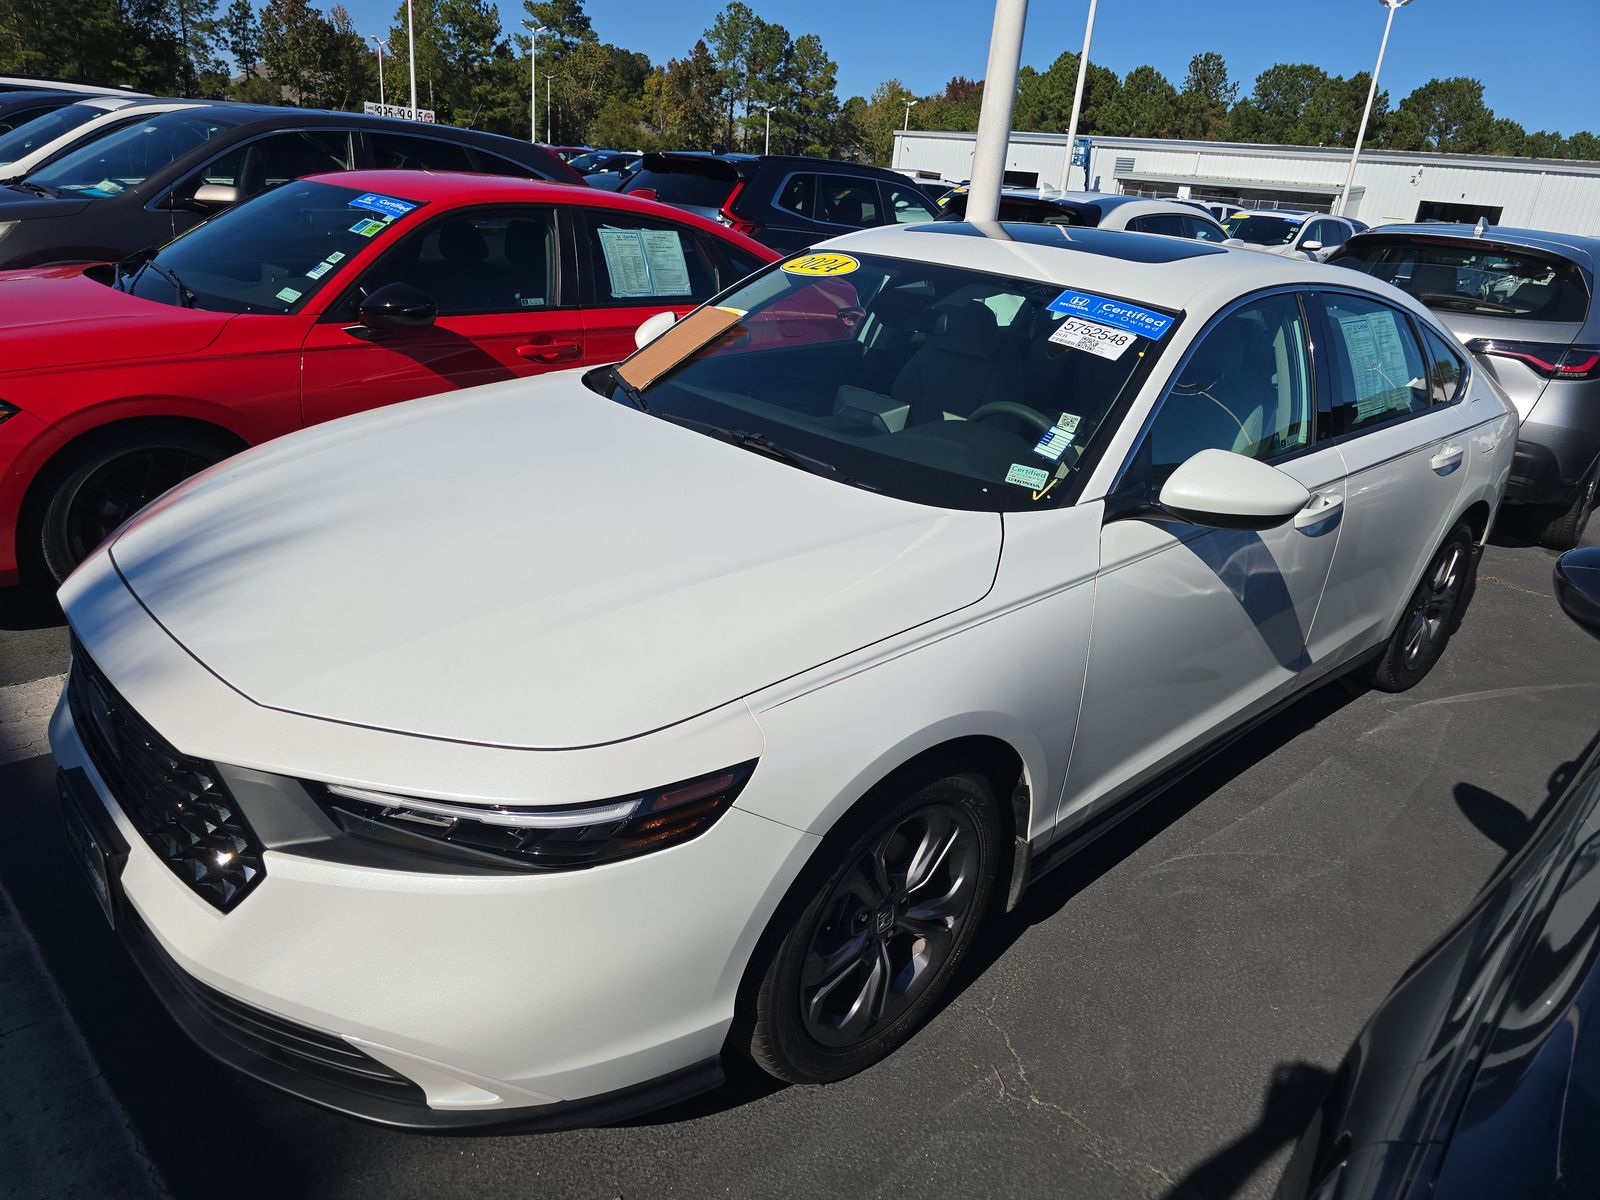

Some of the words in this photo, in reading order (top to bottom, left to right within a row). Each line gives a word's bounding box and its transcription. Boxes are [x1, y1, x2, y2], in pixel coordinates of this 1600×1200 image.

[1059, 302, 1089, 311] HONDA
[1102, 303, 1166, 327] Certified
[1064, 320, 1128, 346] 5752548
[1012, 466, 1046, 478] Certified
